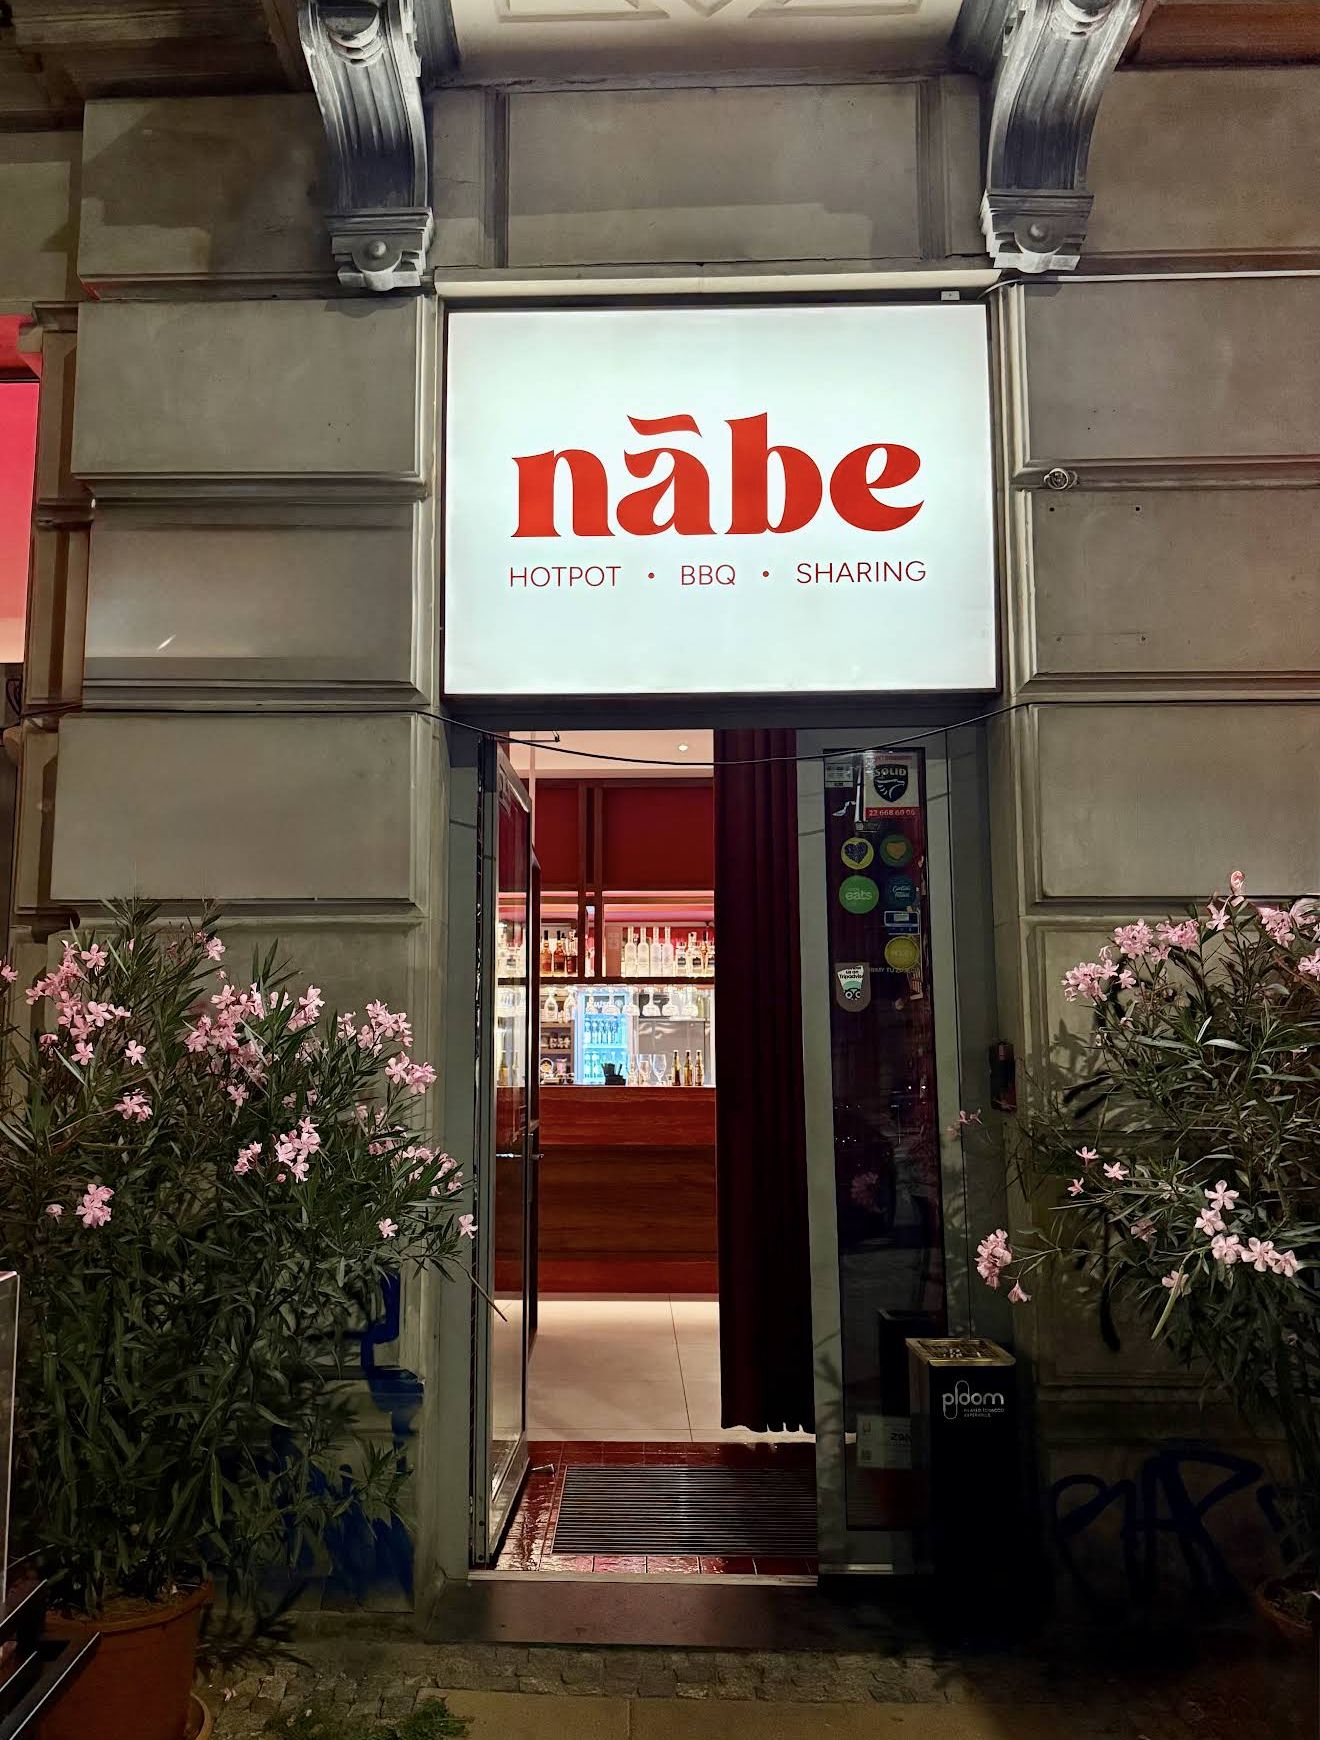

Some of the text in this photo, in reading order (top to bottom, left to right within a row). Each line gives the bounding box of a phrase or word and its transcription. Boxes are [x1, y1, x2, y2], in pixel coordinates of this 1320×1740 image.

[510, 411, 925, 538] nābe
[509, 560, 927, 588] HOTPOT BBQ SHARING
[874, 767, 907, 777] SOLID
[868, 809, 878, 817] 22
[879, 809, 894, 817] 668
[845, 890, 873, 901] eats
[942, 1379, 1005, 1420] ploom
